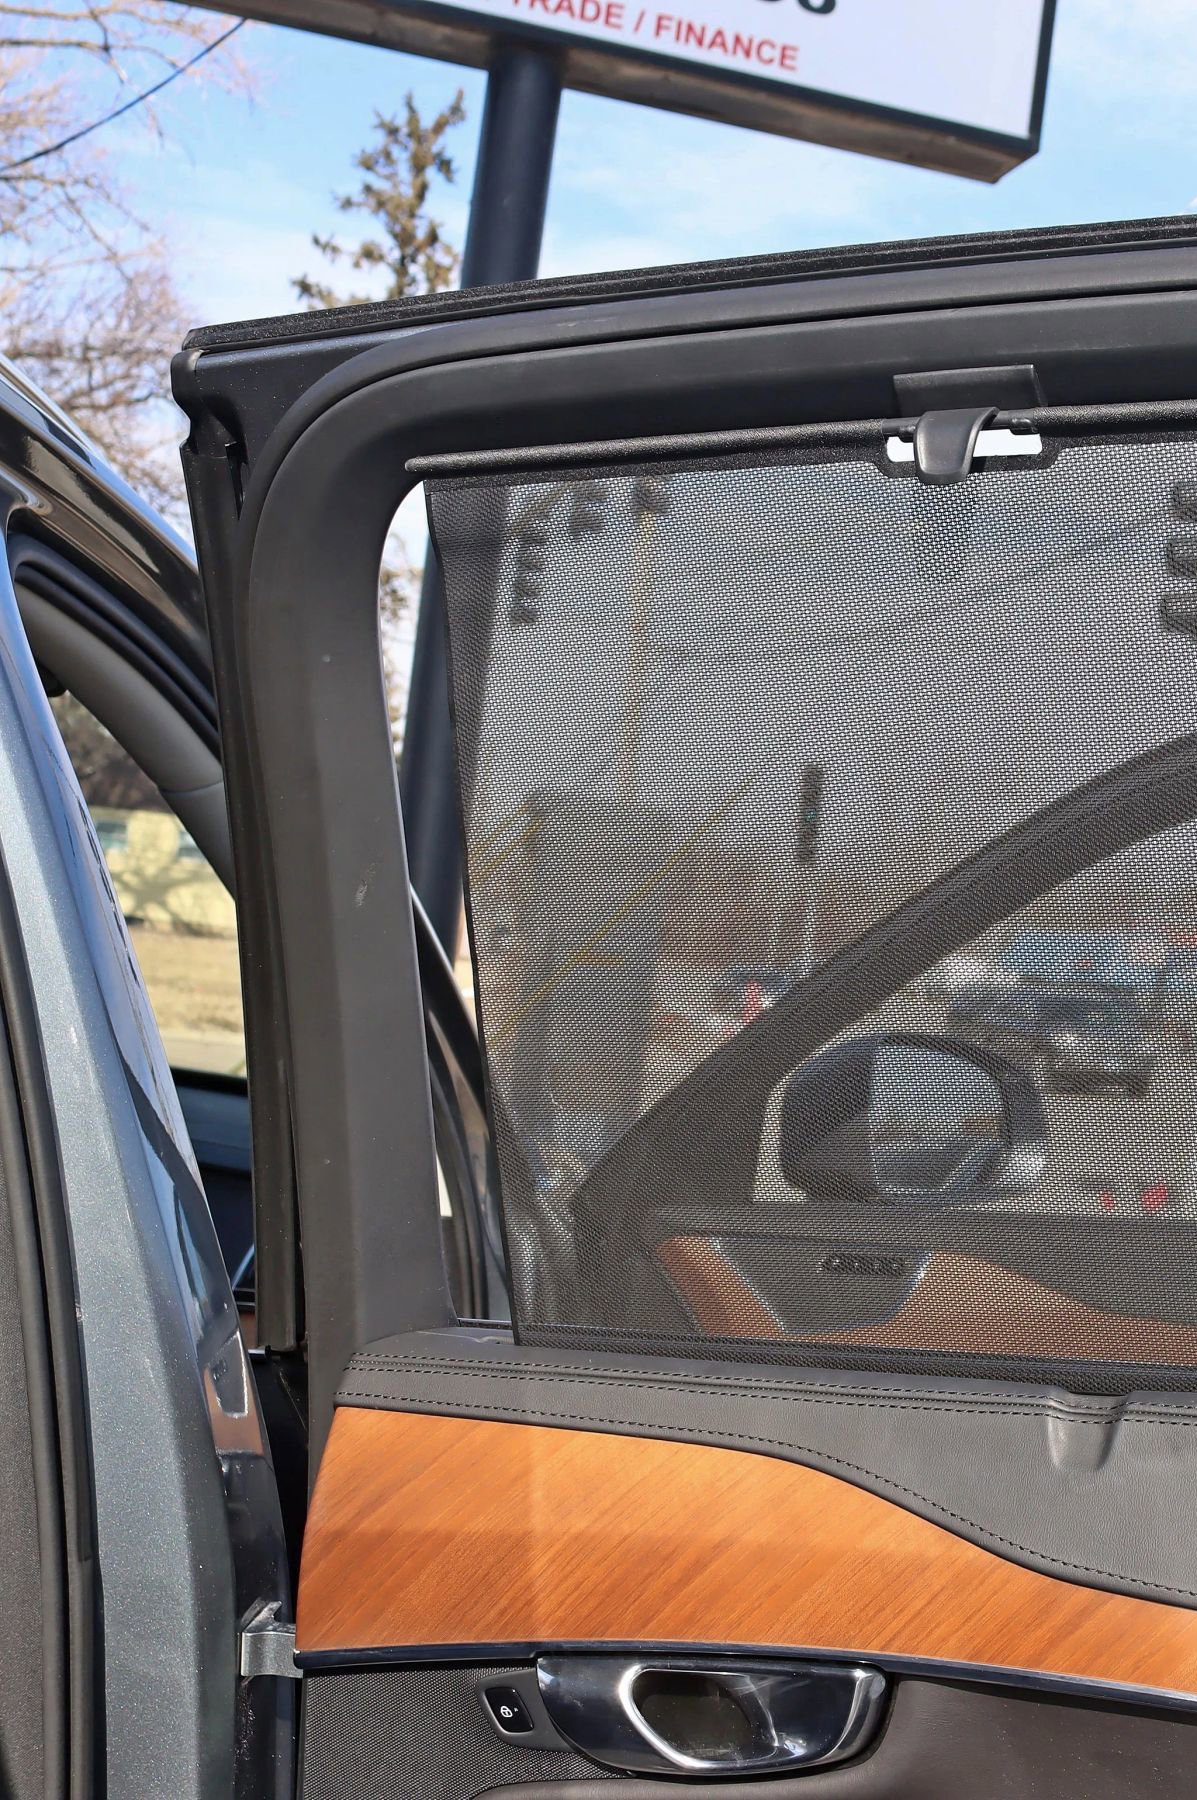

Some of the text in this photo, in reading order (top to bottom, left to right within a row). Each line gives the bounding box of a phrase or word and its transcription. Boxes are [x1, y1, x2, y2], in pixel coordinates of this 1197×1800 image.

[512, 0, 799, 70] RADE / FINANCE
